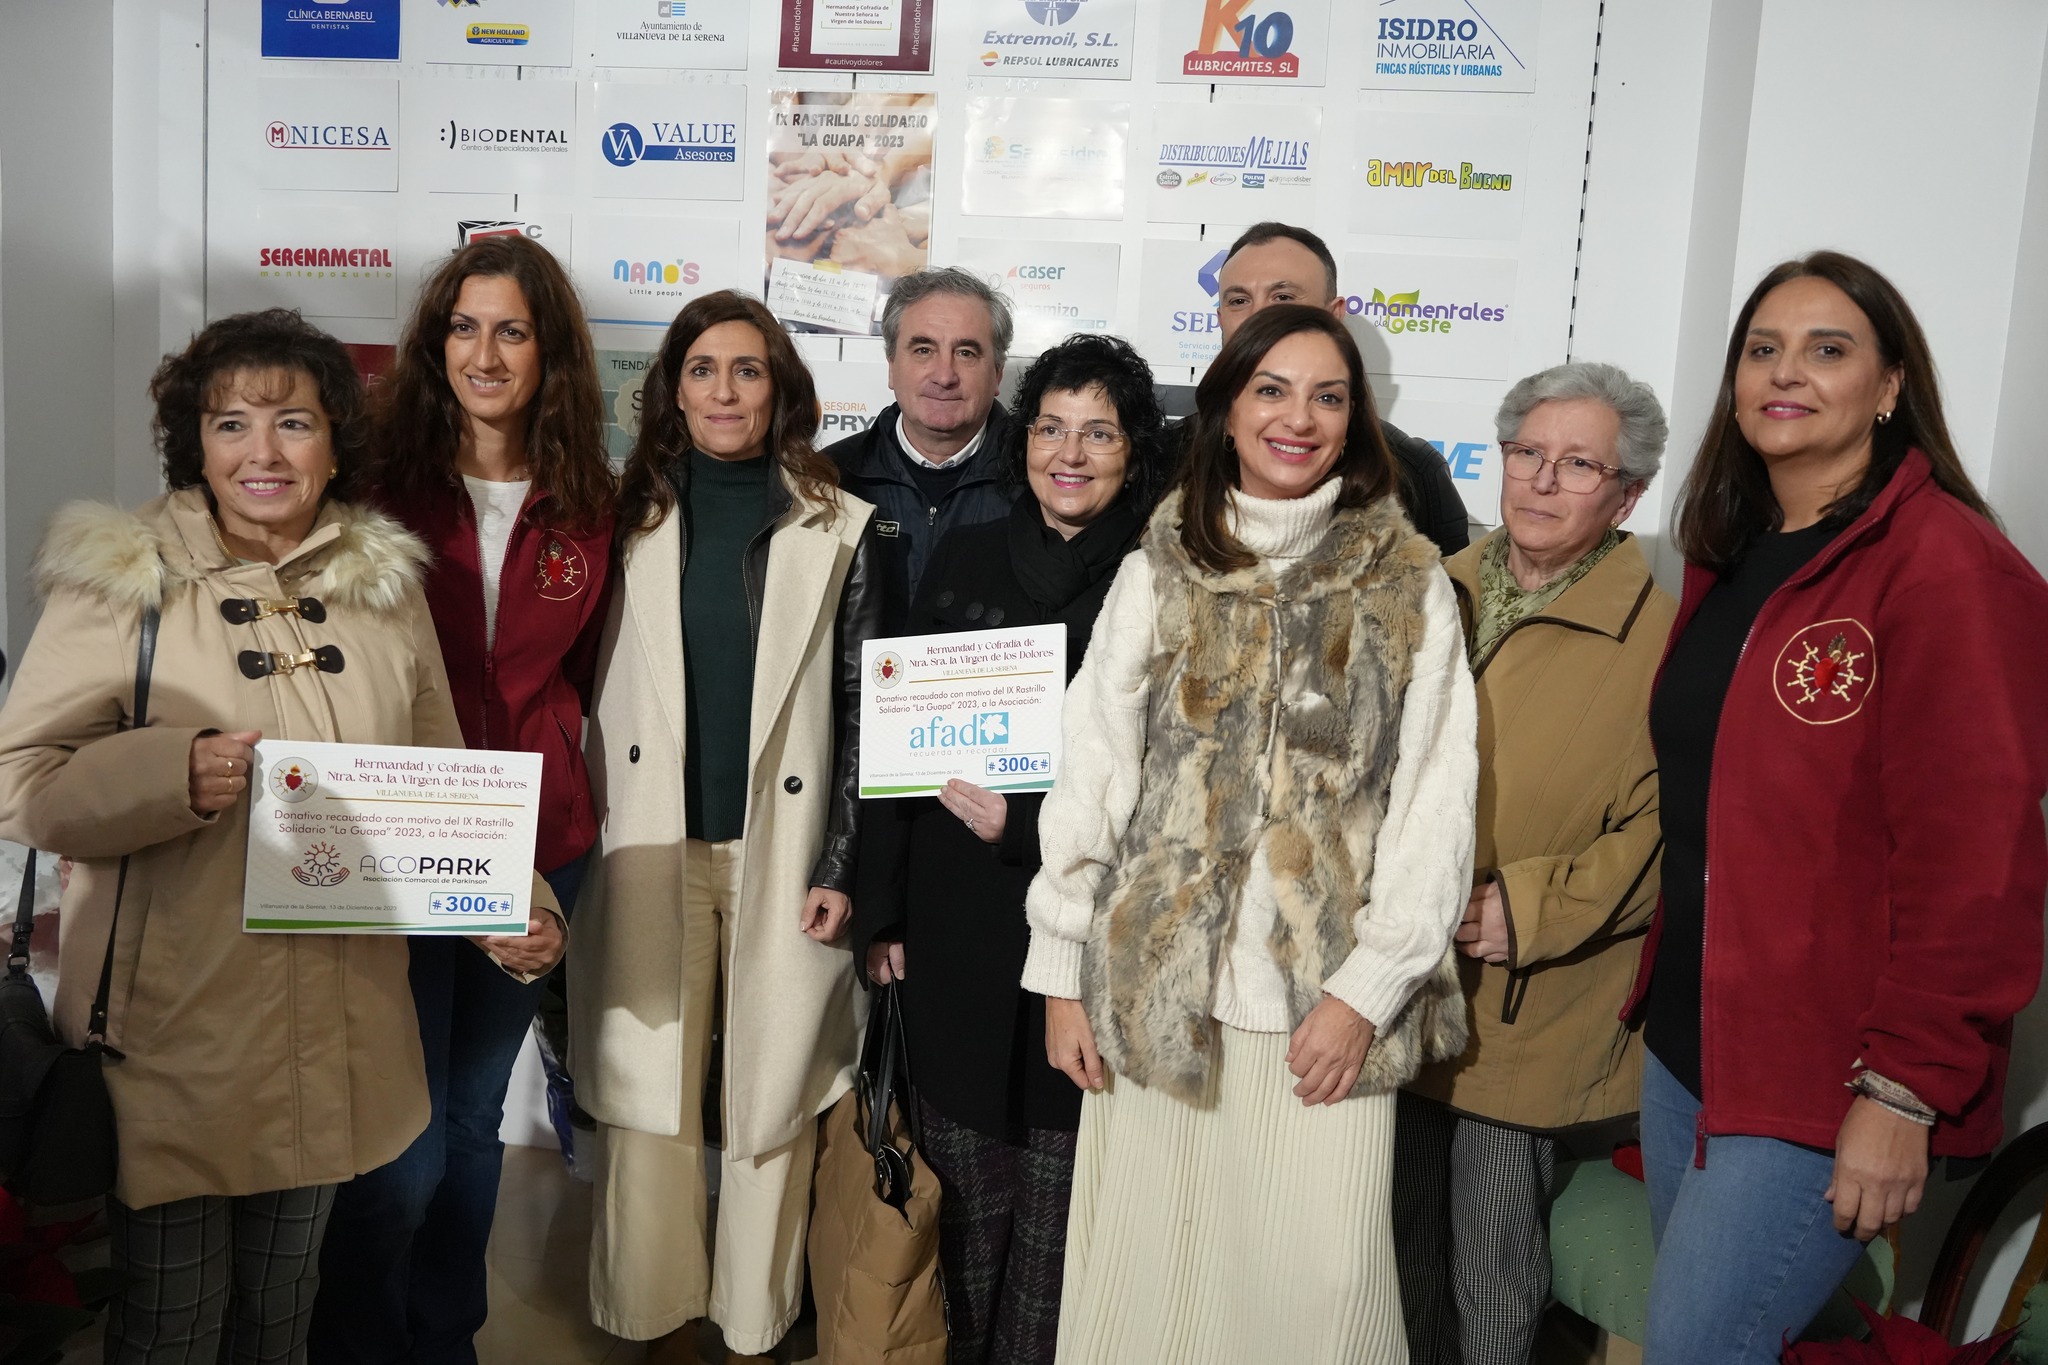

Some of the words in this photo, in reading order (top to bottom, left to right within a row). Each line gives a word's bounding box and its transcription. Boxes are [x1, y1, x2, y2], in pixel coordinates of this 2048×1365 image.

[288, 9, 322, 19] CLÍNICA
[324, 11, 372, 20] BERNABEU
[640, 21, 692, 32] Ayuntamiento
[693, 22, 702, 30] de
[1378, 18, 1478, 41] ISIDRO
[983, 31, 1078, 48] Extremoil,
[1084, 32, 1119, 47] S.L.
[1377, 43, 1496, 60] INMOBILIARIA
[825, 58, 883, 67] #cautivoydolores
[1003, 56, 1042, 66] REPSOL
[1046, 57, 1120, 68] LUBRICANTES
[1188, 60, 1275, 74] LUBRICANTES,
[1278, 62, 1294, 73] SL
[1376, 63, 1407, 74] FINCAS
[1409, 61, 1450, 75] RÚSTICAS
[1453, 64, 1460, 76] Y
[1461, 64, 1502, 76] URBANAS
[776, 113, 788, 126] IX
[792, 114, 860, 127] RASTRILLO
[864, 115, 928, 128] SOLIDARIO
[291, 126, 390, 146] NICESA
[461, 128, 568, 143] BIODENTAL
[652, 122, 736, 144] VALUE
[874, 135, 904, 148] 2023
[674, 148, 733, 162] Asesores
[1160, 144, 1246, 163] DISTRIBUCIONES
[1245, 136, 1310, 168] MEJIAS
[260, 248, 392, 268] SERENAMETAL
[1018, 266, 1066, 280] caser
[1020, 283, 1051, 292] seguros
[1346, 296, 1505, 322] Ornamentales
[1375, 316, 1390, 328] del
[1179, 341, 1210, 350] Servicio
[927, 642, 975, 654] Hermandad
[985, 639, 1021, 650] Cofradía
[1024, 638, 1035, 647] de
[909, 659, 928, 668] Ntra.
[930, 658, 947, 666] Sra.
[950, 656, 957, 664] la
[960, 655, 988, 665] Virgen
[991, 653, 1001, 661] de
[1004, 652, 1017, 660] los
[1020, 650, 1054, 659] Dolores
[943, 668, 976, 676] VILLANUEVA
[876, 694, 908, 703] Donativo
[910, 691, 948, 701] recaudado
[966, 689, 990, 697] motivo
[993, 687, 1004, 695] del
[1007, 686, 1013, 694] IX
[1016, 684, 1046, 693] Rastrillo
[879, 705, 910, 714] Solidario
[957, 700, 980, 709] 2023,
[990, 699, 996, 707] la
[999, 696, 1042, 706] Asociación:
[910, 714, 977, 749] afad
[910, 749, 952, 758] recuerda
[966, 746, 1008, 754] recordar
[354, 758, 423, 771] Hermandad
[426, 764, 434, 774] y
[438, 762, 486, 774] Cofradía
[490, 765, 504, 774] de
[998, 757, 1038, 772] 300€
[328, 771, 356, 782] Ntra.
[359, 773, 383, 783] Sra.
[387, 774, 397, 784] la
[402, 774, 440, 787] Virgen
[444, 777, 458, 786] de
[462, 777, 479, 787] los
[483, 778, 527, 789] Dolores
[376, 789, 422, 798] VILLANUEVA
[450, 792, 479, 800] SERENA
[274, 810, 322, 820] Donativo
[326, 813, 382, 823] recaudado
[407, 815, 441, 825] motivo
[444, 816, 460, 826] del
[463, 817, 473, 826] IX
[475, 817, 514, 827] Rastrillo
[279, 823, 326, 834] Solidario
[395, 827, 425, 838] 2023,
[439, 828, 448, 838] la
[451, 830, 508, 840] Asociación:
[360, 855, 492, 876] ACOPARK
[404, 876, 440, 884] Comarcal
[445, 896, 498, 912] 300€
